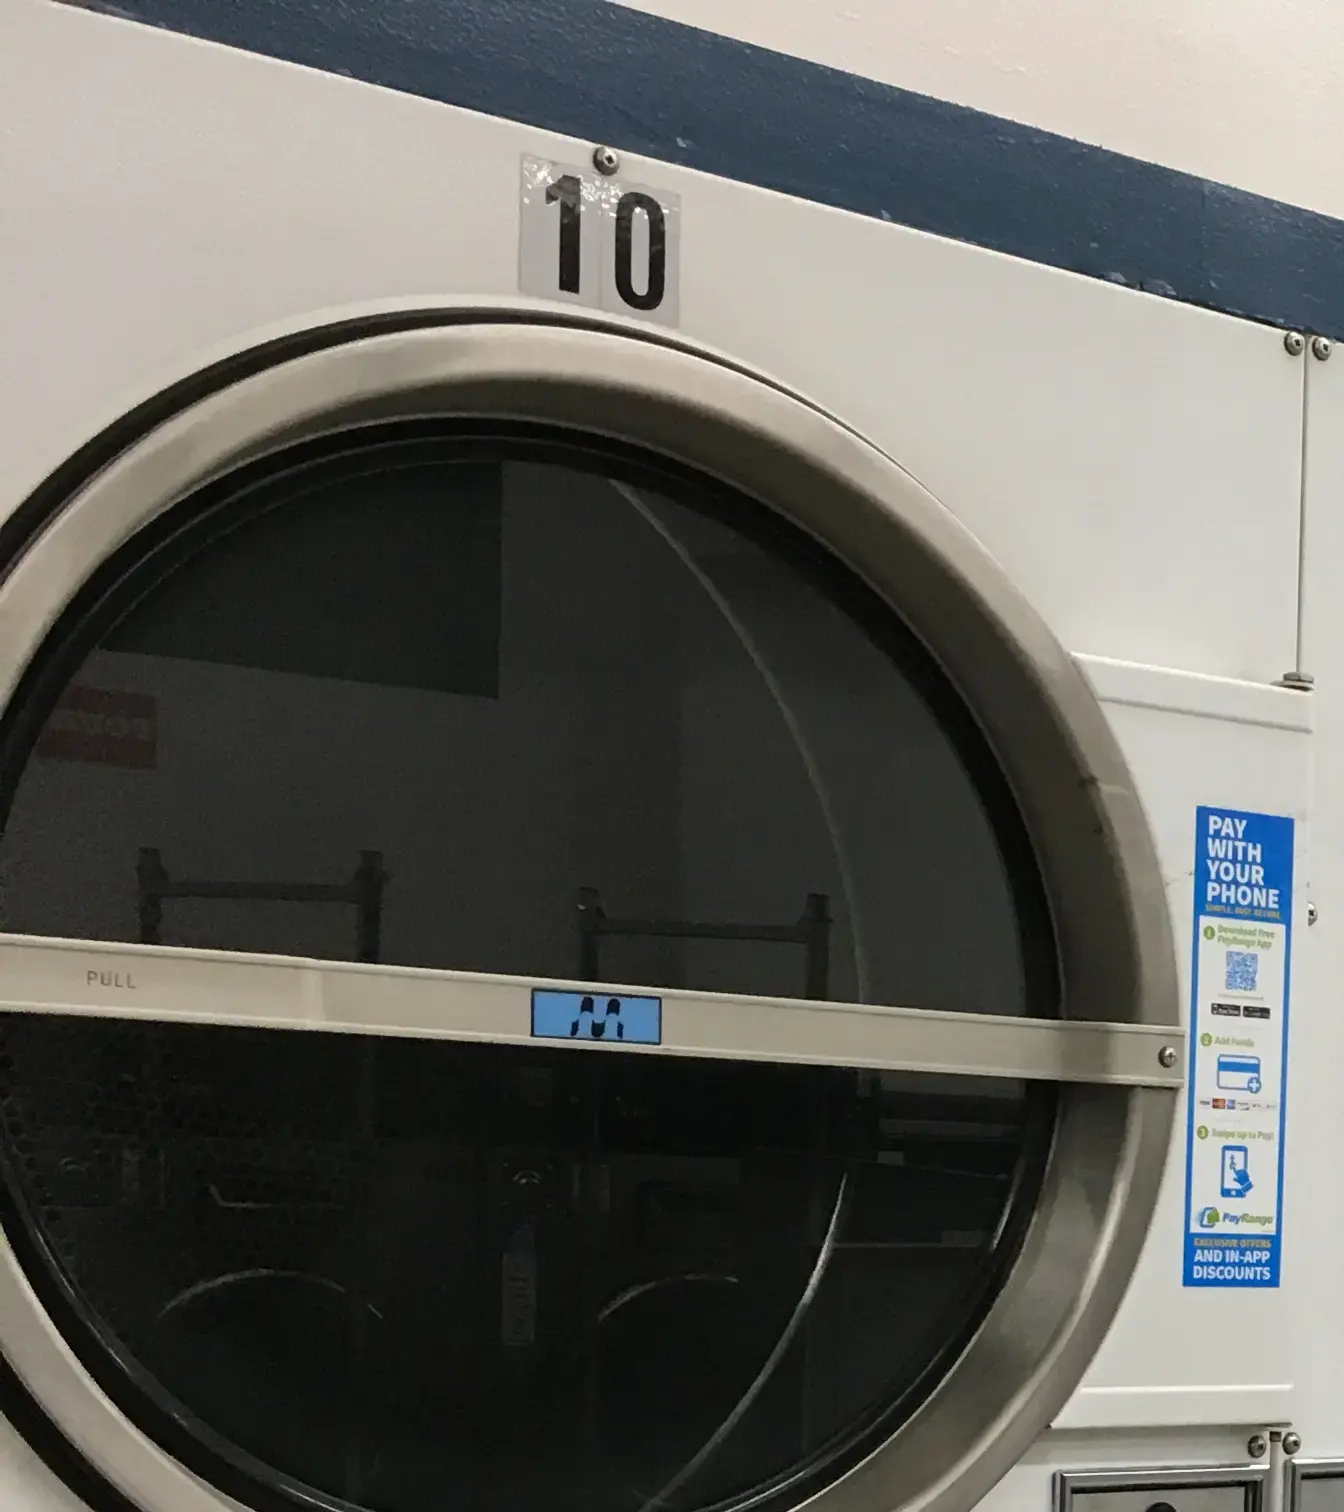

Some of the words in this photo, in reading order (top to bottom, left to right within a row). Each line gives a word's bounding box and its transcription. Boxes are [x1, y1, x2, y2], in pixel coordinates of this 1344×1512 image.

[545, 174, 666, 311] 10
[1207, 814, 1248, 840] PAY
[1207, 837, 1262, 864] WITH
[1206, 859, 1265, 886] YOUR
[1206, 881, 1280, 910] PHONE
[86, 969, 137, 989] PULL
[1193, 1248, 1224, 1263] AND
[1225, 1249, 1271, 1264] IN-APP
[1192, 1265, 1271, 1281] DISCOUNTS
